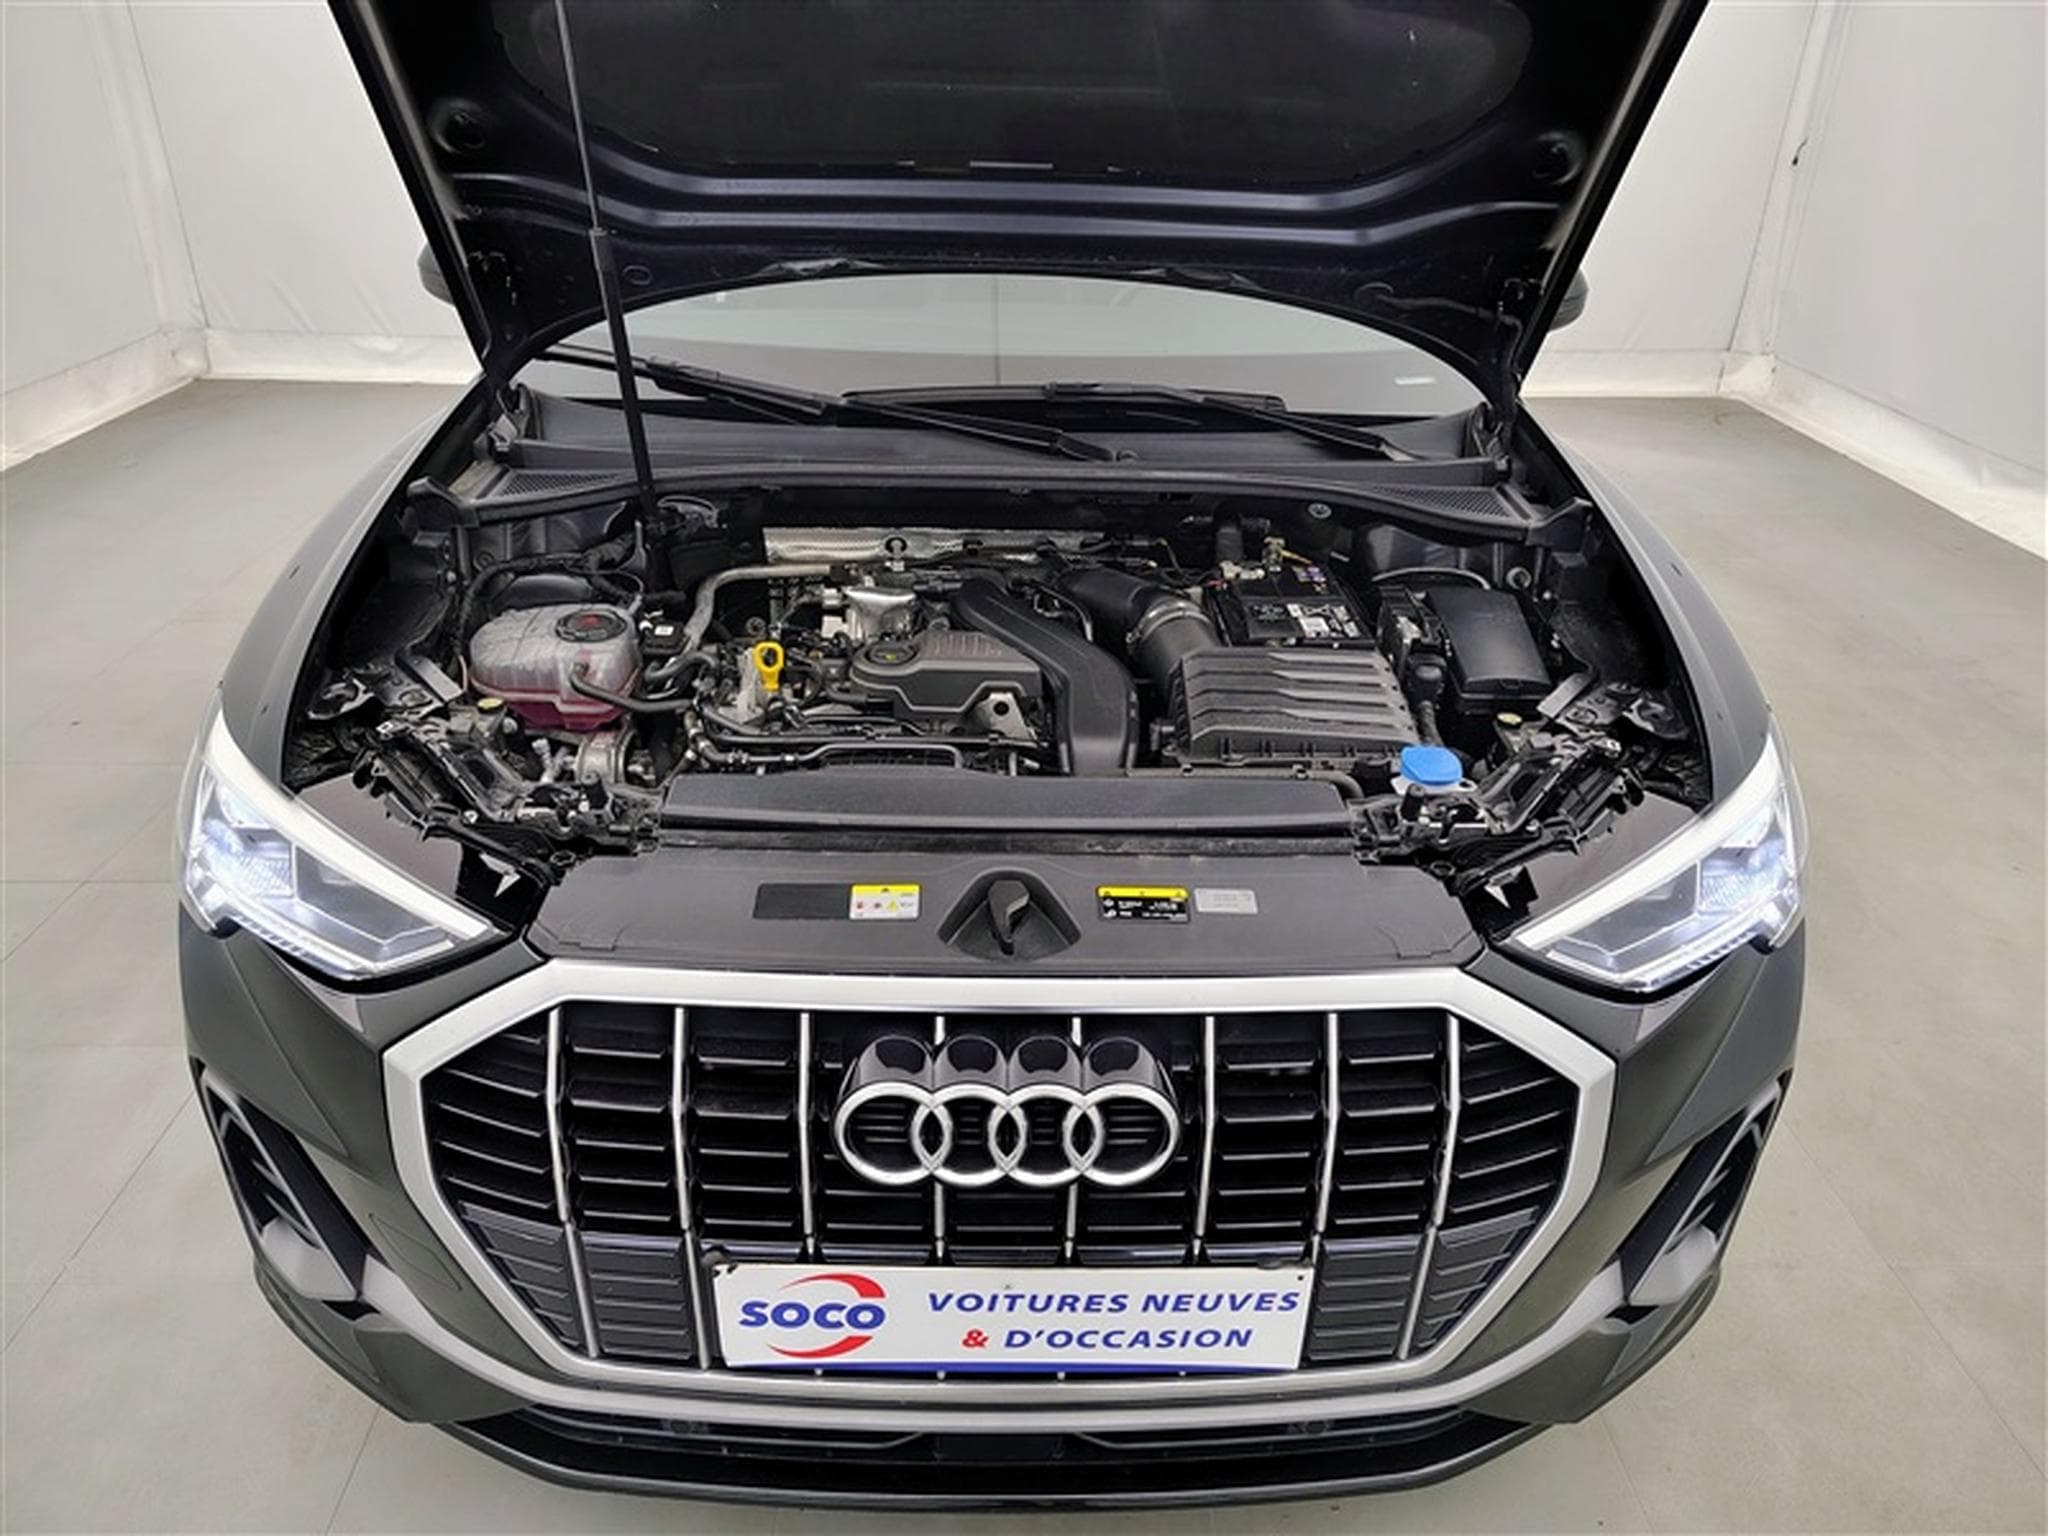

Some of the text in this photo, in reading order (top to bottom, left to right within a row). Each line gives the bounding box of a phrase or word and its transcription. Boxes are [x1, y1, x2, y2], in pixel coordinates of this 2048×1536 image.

[928, 1291, 1300, 1313] VOITURES NEUVES
[738, 1300, 887, 1331] SOCO
[960, 1328, 1253, 1349] & D'OCCASION
